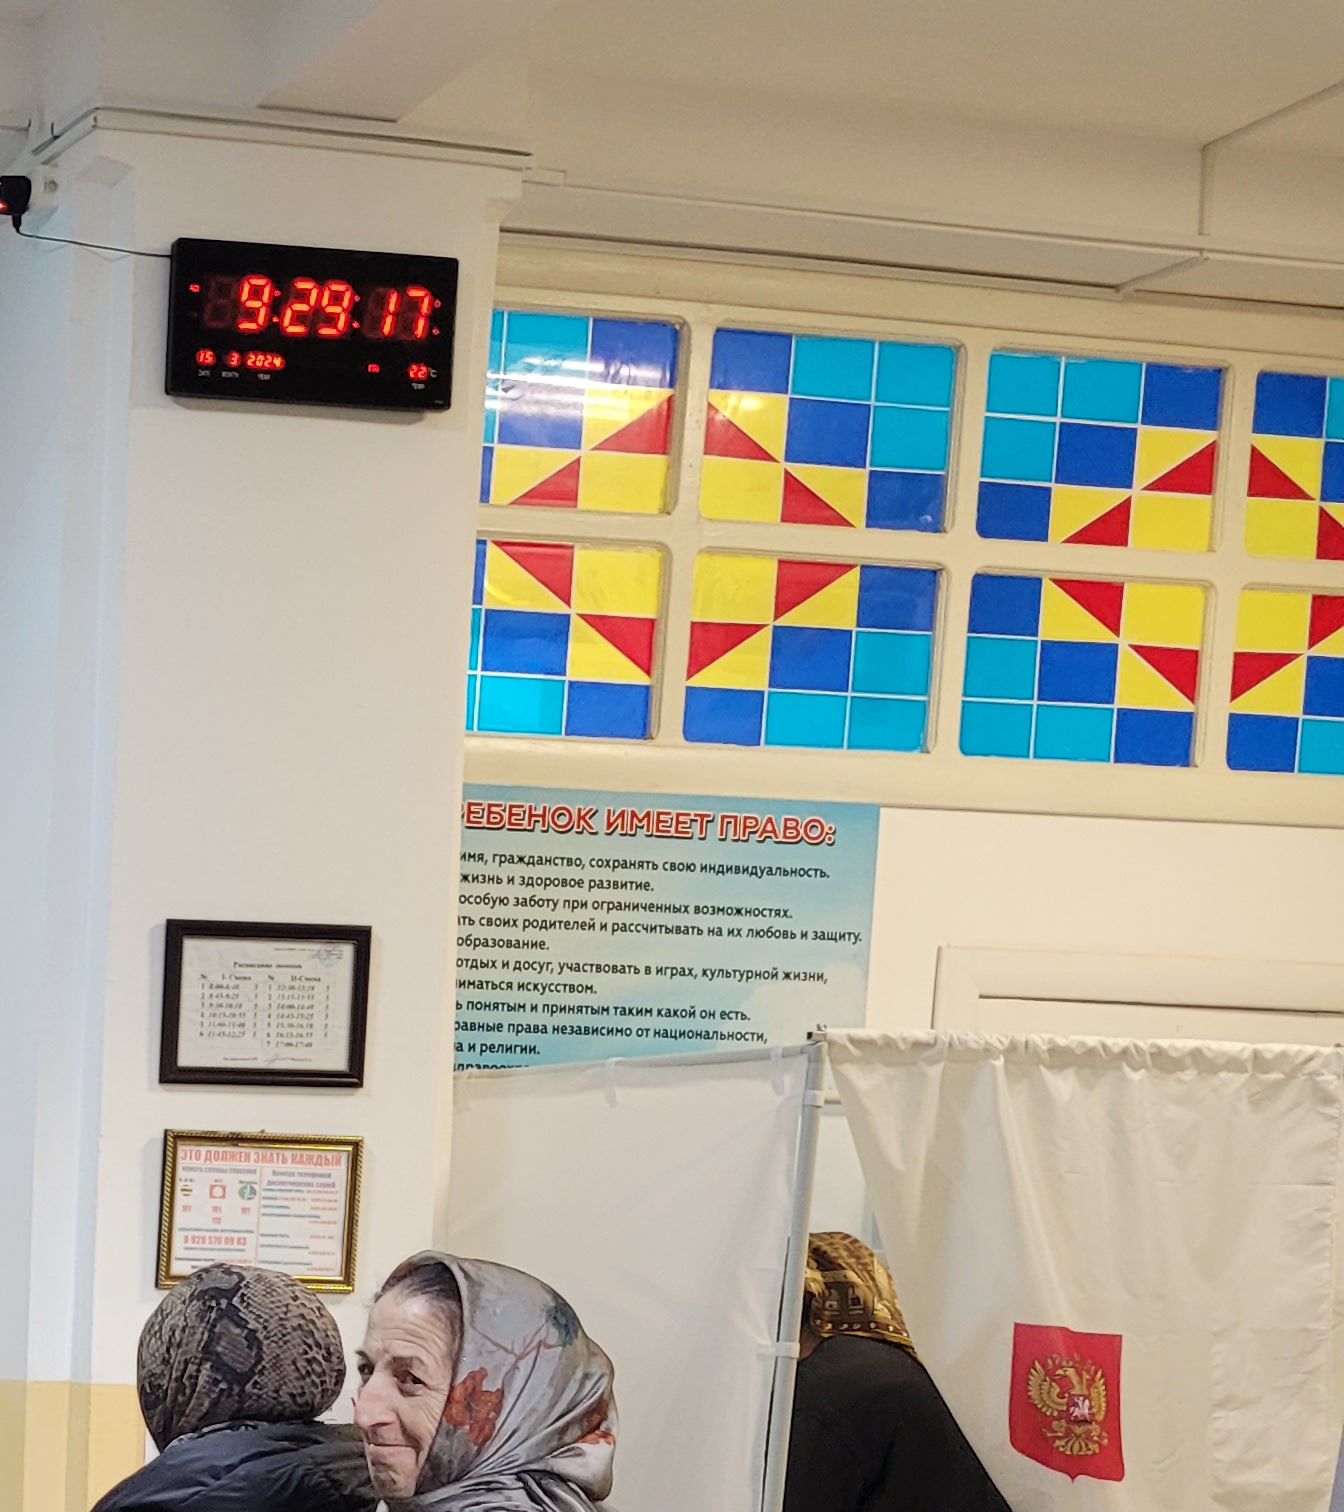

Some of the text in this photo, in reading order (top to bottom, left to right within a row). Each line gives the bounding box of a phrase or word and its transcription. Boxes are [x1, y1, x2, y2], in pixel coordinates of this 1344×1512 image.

[246, 351, 282, 368] 2024
[409, 363, 427, 378] 22
[461, 801, 836, 846] ЕБЕНОК ИМЕЕТ ПРАВО:
[492, 853, 585, 871] гражданство,
[589, 857, 658, 872] сохранять
[662, 861, 697, 872] свою
[700, 863, 830, 879] индивидуальность.
[460, 872, 654, 892] жизнь и здоровое развитие.
[458, 892, 793, 919] особую заботу при ограниченных возможностях.
[479, 916, 518, 928] своих
[522, 917, 595, 931] родителей
[600, 920, 607, 931] и
[611, 921, 704, 937] рассчитывать
[708, 926, 723, 937] на
[727, 927, 742, 938] их
[746, 926, 796, 940] любовь
[800, 929, 808, 940] и
[812, 930, 862, 945] защиту.
[456, 934, 550, 950] образование.
[456, 958, 828, 984] отдых и досуг, участвовать в играх, культурной жизни,
[456, 978, 598, 996] иматься искусством.
[466, 1001, 526, 1013] понятым
[530, 1002, 538, 1013] и
[542, 1003, 610, 1017] принятым
[613, 1005, 653, 1018] таким
[657, 1005, 696, 1019] какой
[699, 1010, 716, 1020] он
[720, 1010, 751, 1021] есть.
[507, 1022, 548, 1036] права
[552, 1024, 633, 1037] независимо
[636, 1028, 650, 1038] от
[653, 1028, 768, 1044] национальности,
[468, 1042, 476, 1053] и
[480, 1043, 541, 1056] религии.
[180, 1149, 342, 1168] ЭТО ДОЛЖЕН ЗНАТЬ КАЖДЫЙ
